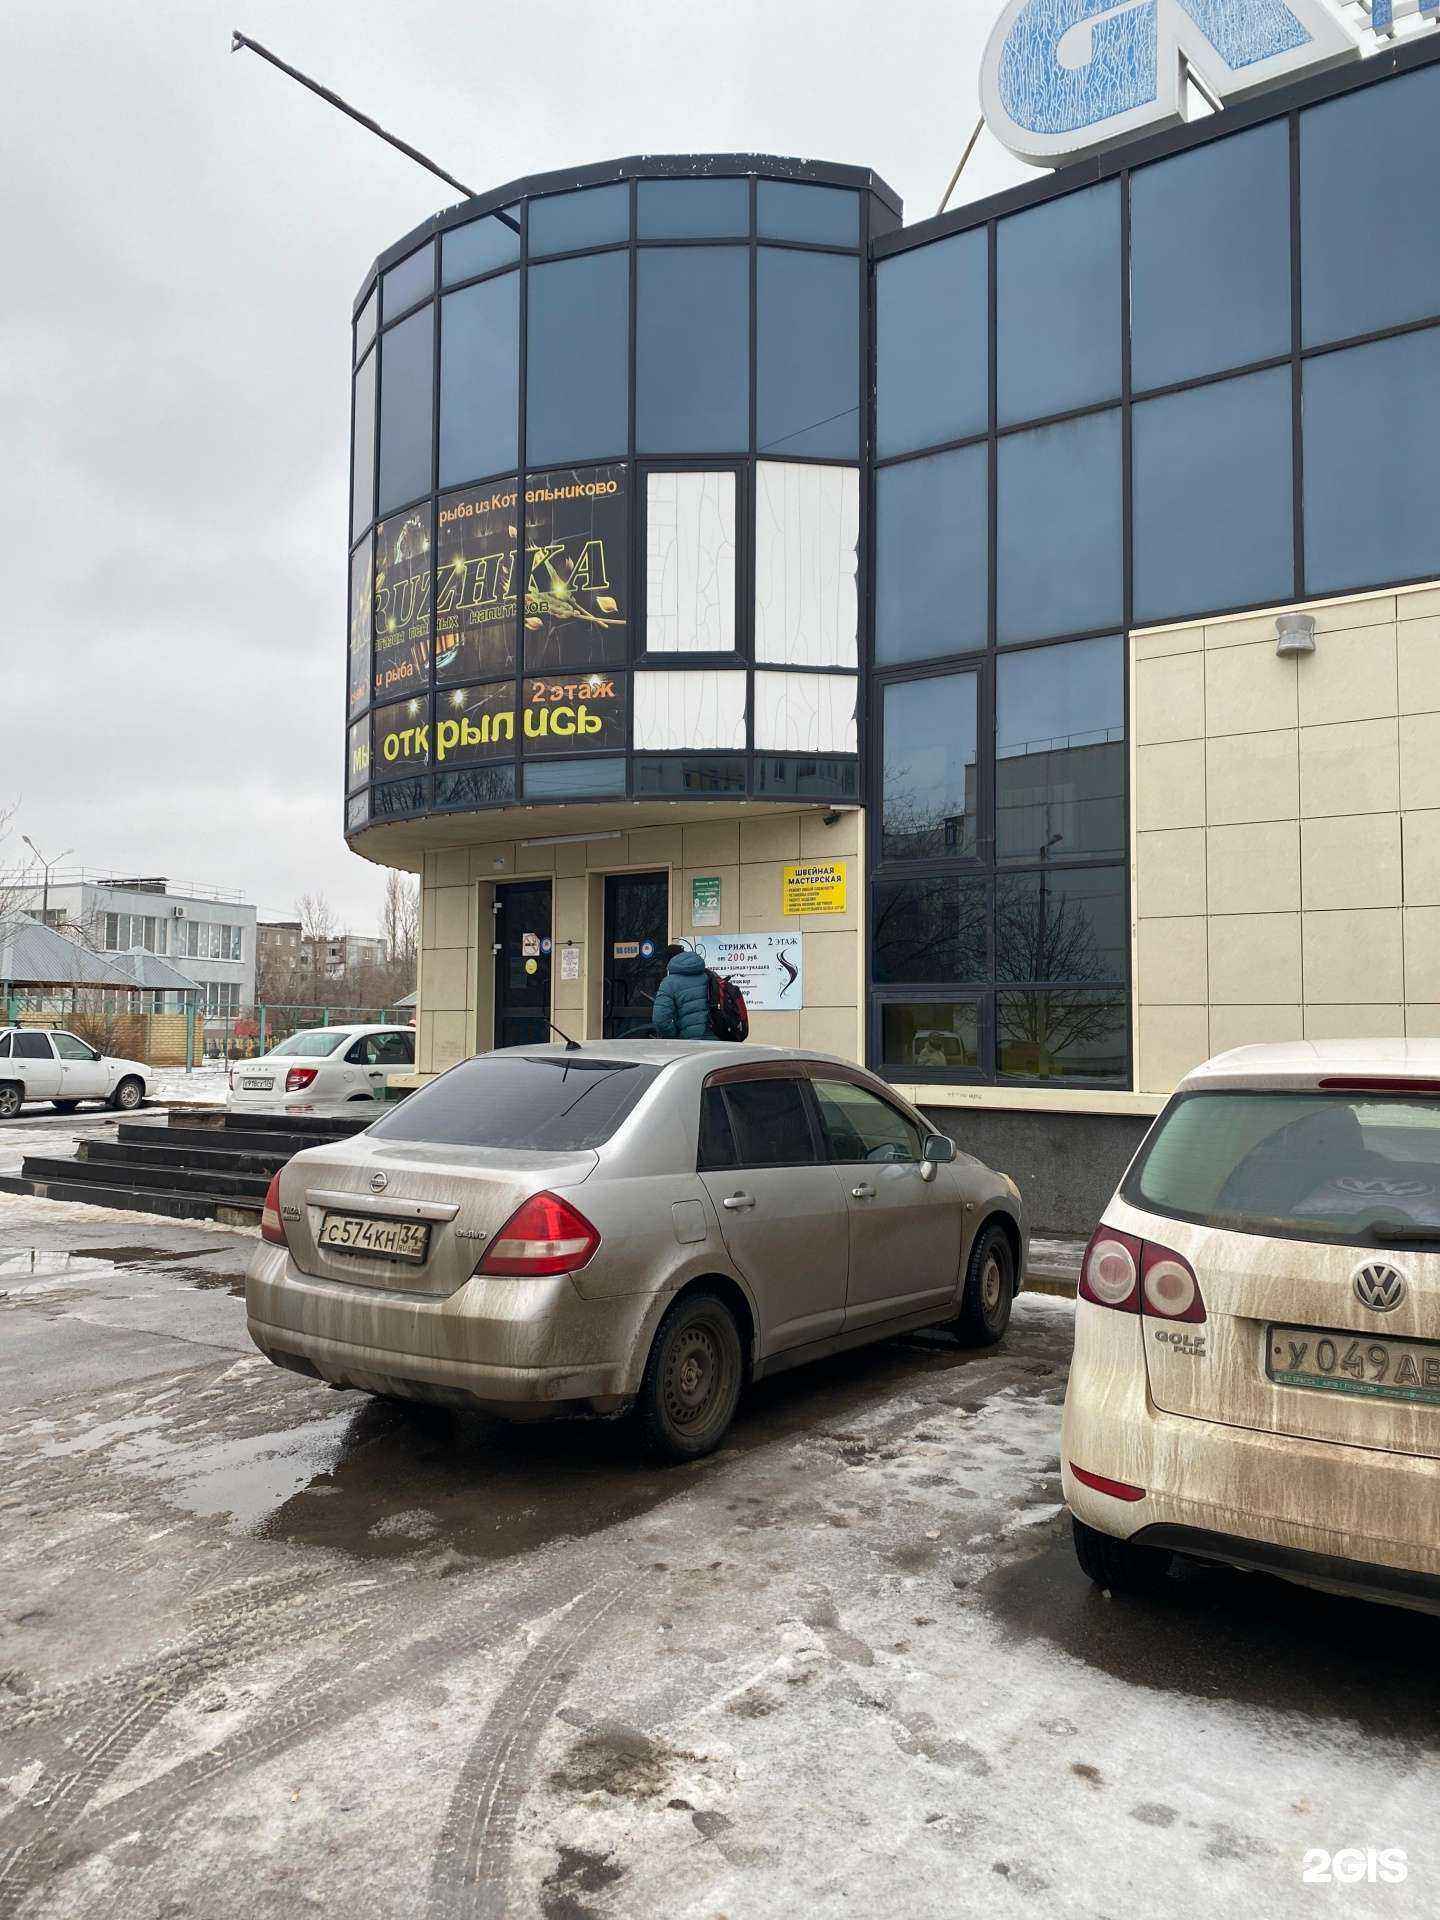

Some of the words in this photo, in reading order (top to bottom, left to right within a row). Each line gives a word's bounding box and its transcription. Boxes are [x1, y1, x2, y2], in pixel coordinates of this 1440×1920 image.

[439, 502, 473, 527] рыба
[475, 499, 490, 515] из
[491, 479, 619, 510] Котельниково
[385, 660, 414, 688] рыба
[531, 681, 546, 703] 2
[549, 680, 616, 702] этаж
[383, 704, 603, 762] открылись
[795, 866, 835, 876] ШВЕЙНАЯ
[788, 875, 842, 885] МАСТЕРСКАЯ
[706, 897, 718, 907] 22
[768, 937, 773, 946] 2
[775, 937, 799, 946] ЭТАЖ
[718, 943, 758, 951] СТРИЖКА
[727, 953, 745, 962] 200
[1154, 1330, 1207, 1348] GOLF
